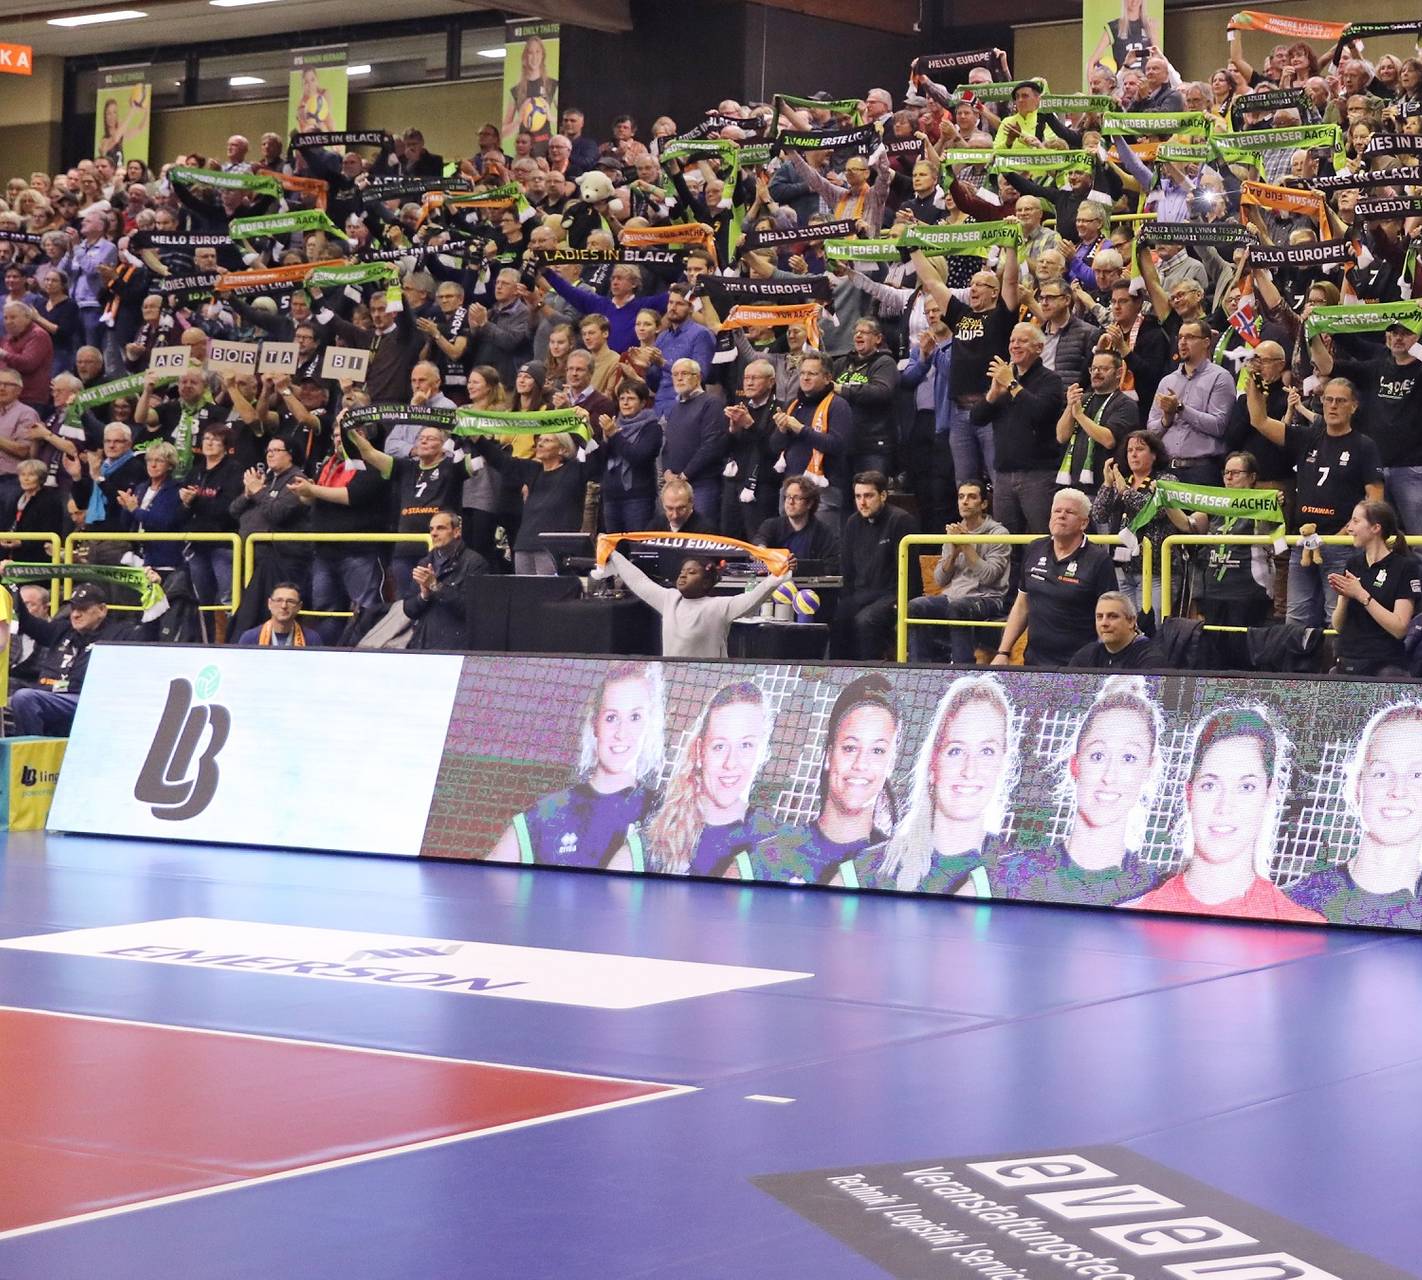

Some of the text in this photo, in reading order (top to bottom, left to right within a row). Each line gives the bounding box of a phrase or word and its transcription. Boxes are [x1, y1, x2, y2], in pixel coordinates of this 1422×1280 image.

[929, 57, 955, 69] HELLO
[1040, 99, 1089, 108] JEDER FASER
[1120, 119, 1147, 129] JEDER
[1149, 118, 1178, 128] FASER
[331, 135, 343, 143] IN
[345, 133, 381, 143] BLACK
[820, 136, 847, 147] ERSTE
[1216, 137, 1236, 148] MIT
[1237, 135, 1267, 148] JEDER
[1268, 132, 1302, 143] FASER
[1399, 137, 1413, 149] IN
[1167, 146, 1193, 156] JEDER
[1006, 156, 1063, 166] JEDER FASER
[1354, 172, 1369, 184] IN
[1372, 165, 1420, 181] BLACK
[265, 218, 295, 230] FASER
[759, 220, 849, 243] HELLO EUROPE!
[922, 231, 950, 243] JEDER
[951, 230, 980, 242] FASER
[151, 235, 186, 245] HELLO
[544, 249, 676, 263] LADIES IN BLACK
[828, 244, 880, 256] MIT JEDER
[1288, 244, 1345, 261] EUROPE!
[160, 277, 196, 291] ADIES IN
[1369, 270, 1378, 285] 7
[760, 283, 812, 295] EUROPE!
[1293, 294, 1305, 309] 7
[100, 381, 129, 398] JEDER
[1316, 466, 1330, 487] 7
[414, 482, 427, 498] 7
[1194, 493, 1278, 512] FASER AACHEN
[107, 944, 528, 994] EMERSON
[827, 1173, 1032, 1280] Technik Logistik Servic
